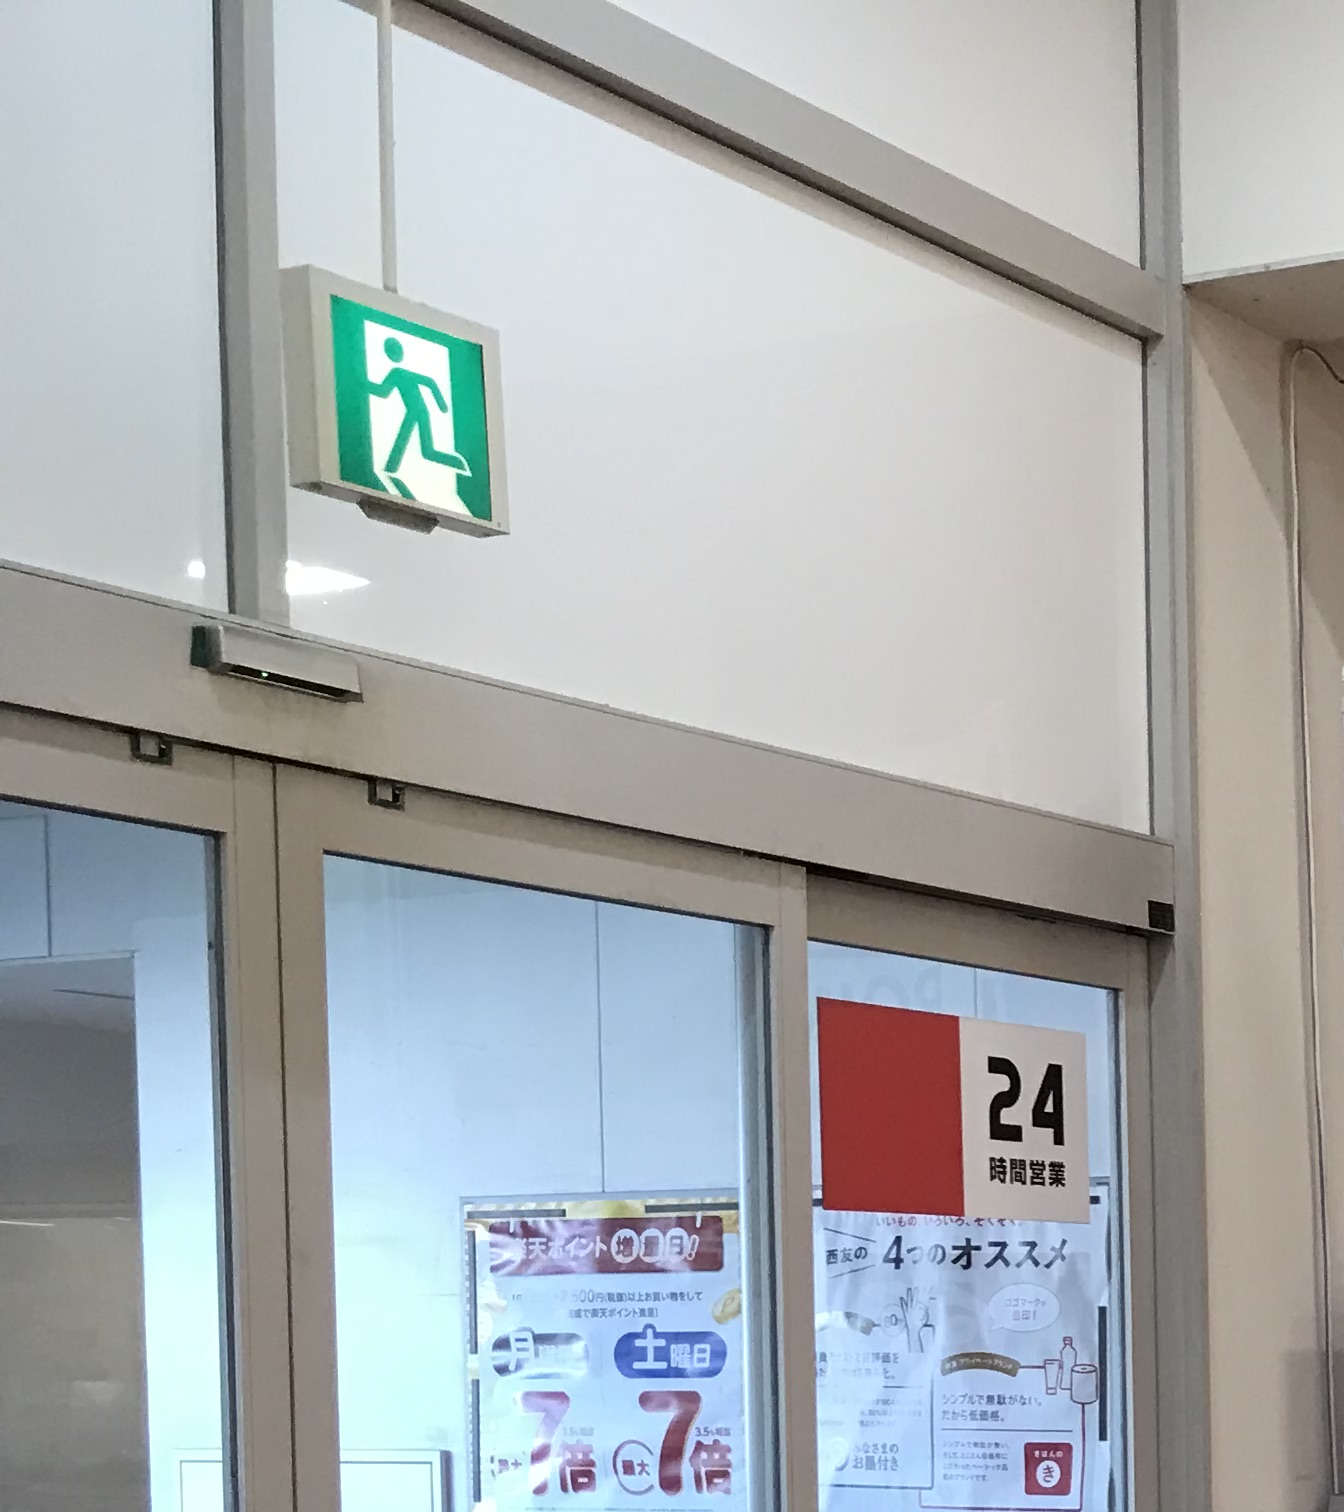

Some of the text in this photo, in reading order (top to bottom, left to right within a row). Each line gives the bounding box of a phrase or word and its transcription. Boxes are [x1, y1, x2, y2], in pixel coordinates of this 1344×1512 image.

[987, 1056, 1066, 1146] 24
[988, 1157, 1067, 1187] 時間営業
[882, 1235, 1068, 1271] 4つのオススメ
[632, 1327, 711, 1370] 土曜日
